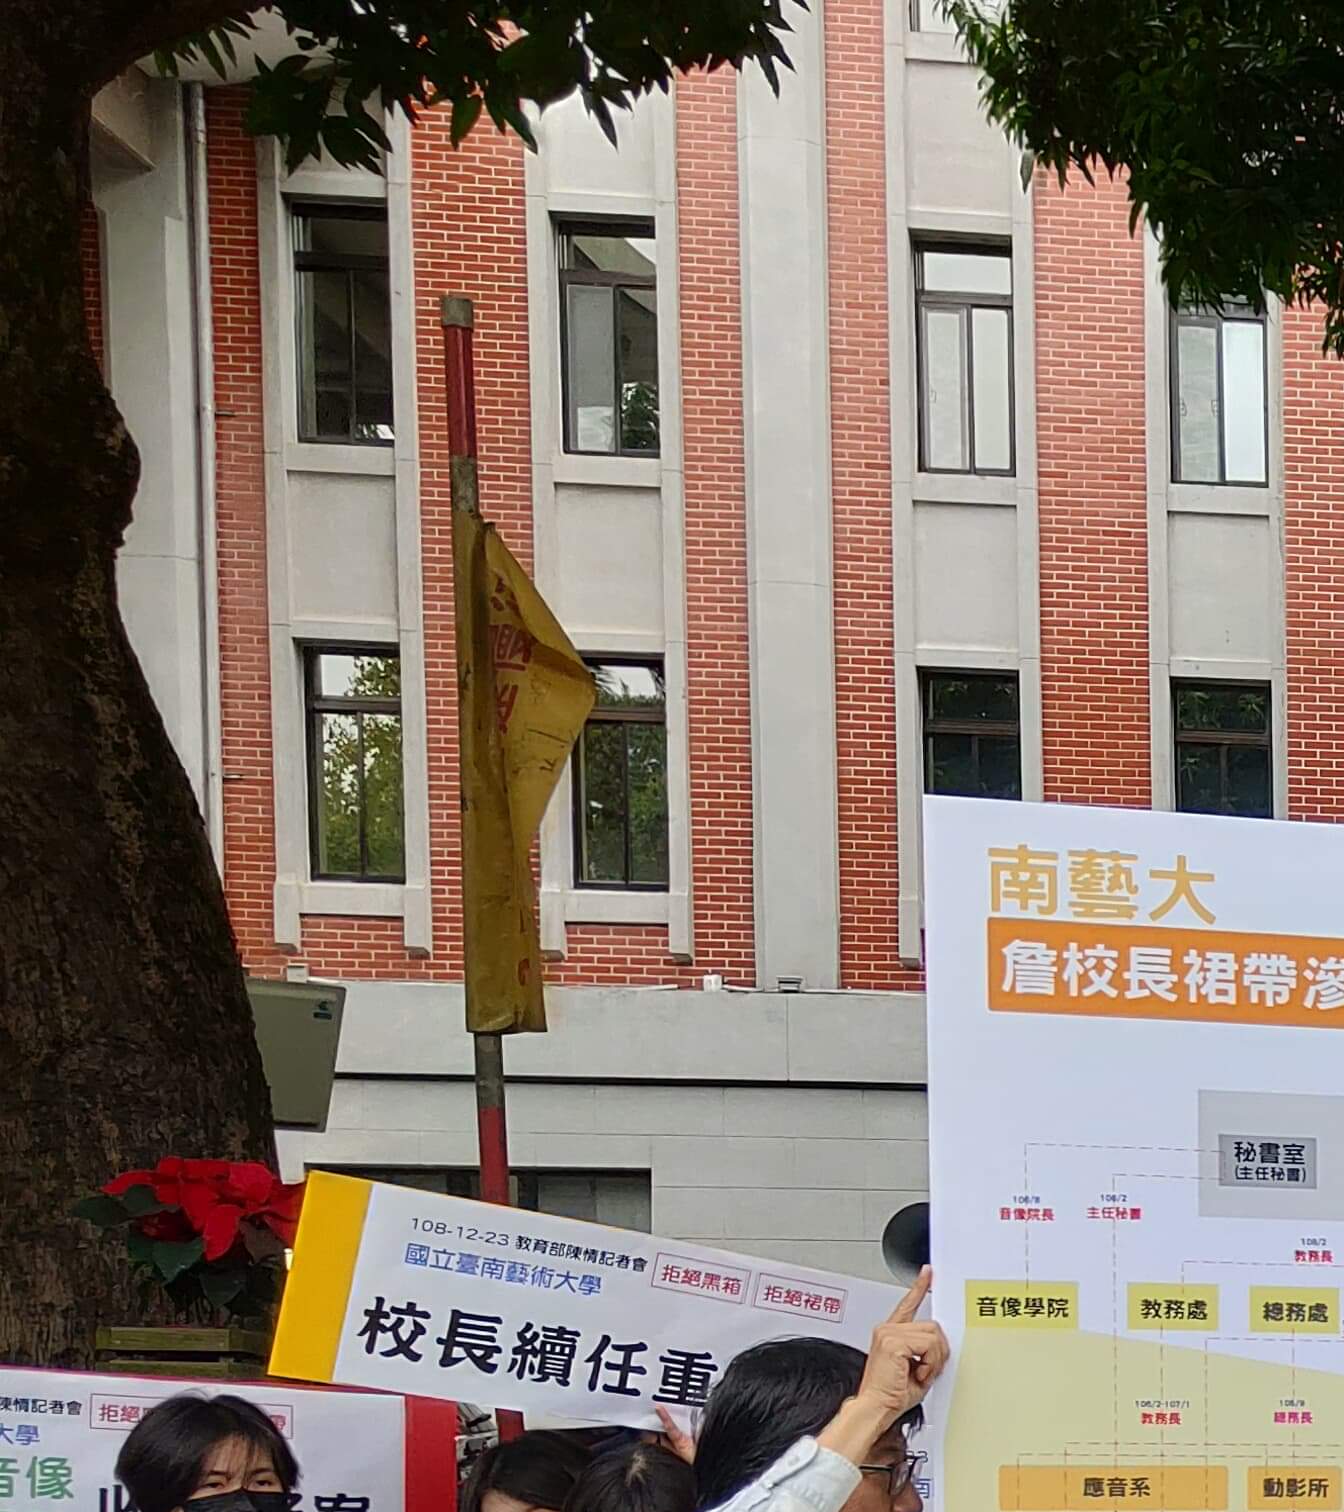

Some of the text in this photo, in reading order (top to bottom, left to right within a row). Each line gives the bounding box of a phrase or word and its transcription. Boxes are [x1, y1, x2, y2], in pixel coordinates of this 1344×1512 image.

[988, 844, 1216, 925] 南藝大
[1234, 1141, 1305, 1166] 秘書室
[1233, 1166, 1307, 1183] (主任秘書)
[411, 1217, 648, 1273] 108-12-23 教育部陳情記者會
[404, 1242, 603, 1297] 國立臺南藝術大學
[661, 1264, 742, 1296] 拒絕黑箱
[763, 1284, 841, 1315] 拒絕裙帶
[976, 1296, 1070, 1319] 音像學院
[1140, 1299, 1209, 1321] 教務處
[1262, 1302, 1329, 1323] 總務處
[356, 1295, 718, 1409] 校長續任重
[1083, 1477, 1151, 1498] 應音系
[1263, 1477, 1329, 1498] 動影所
